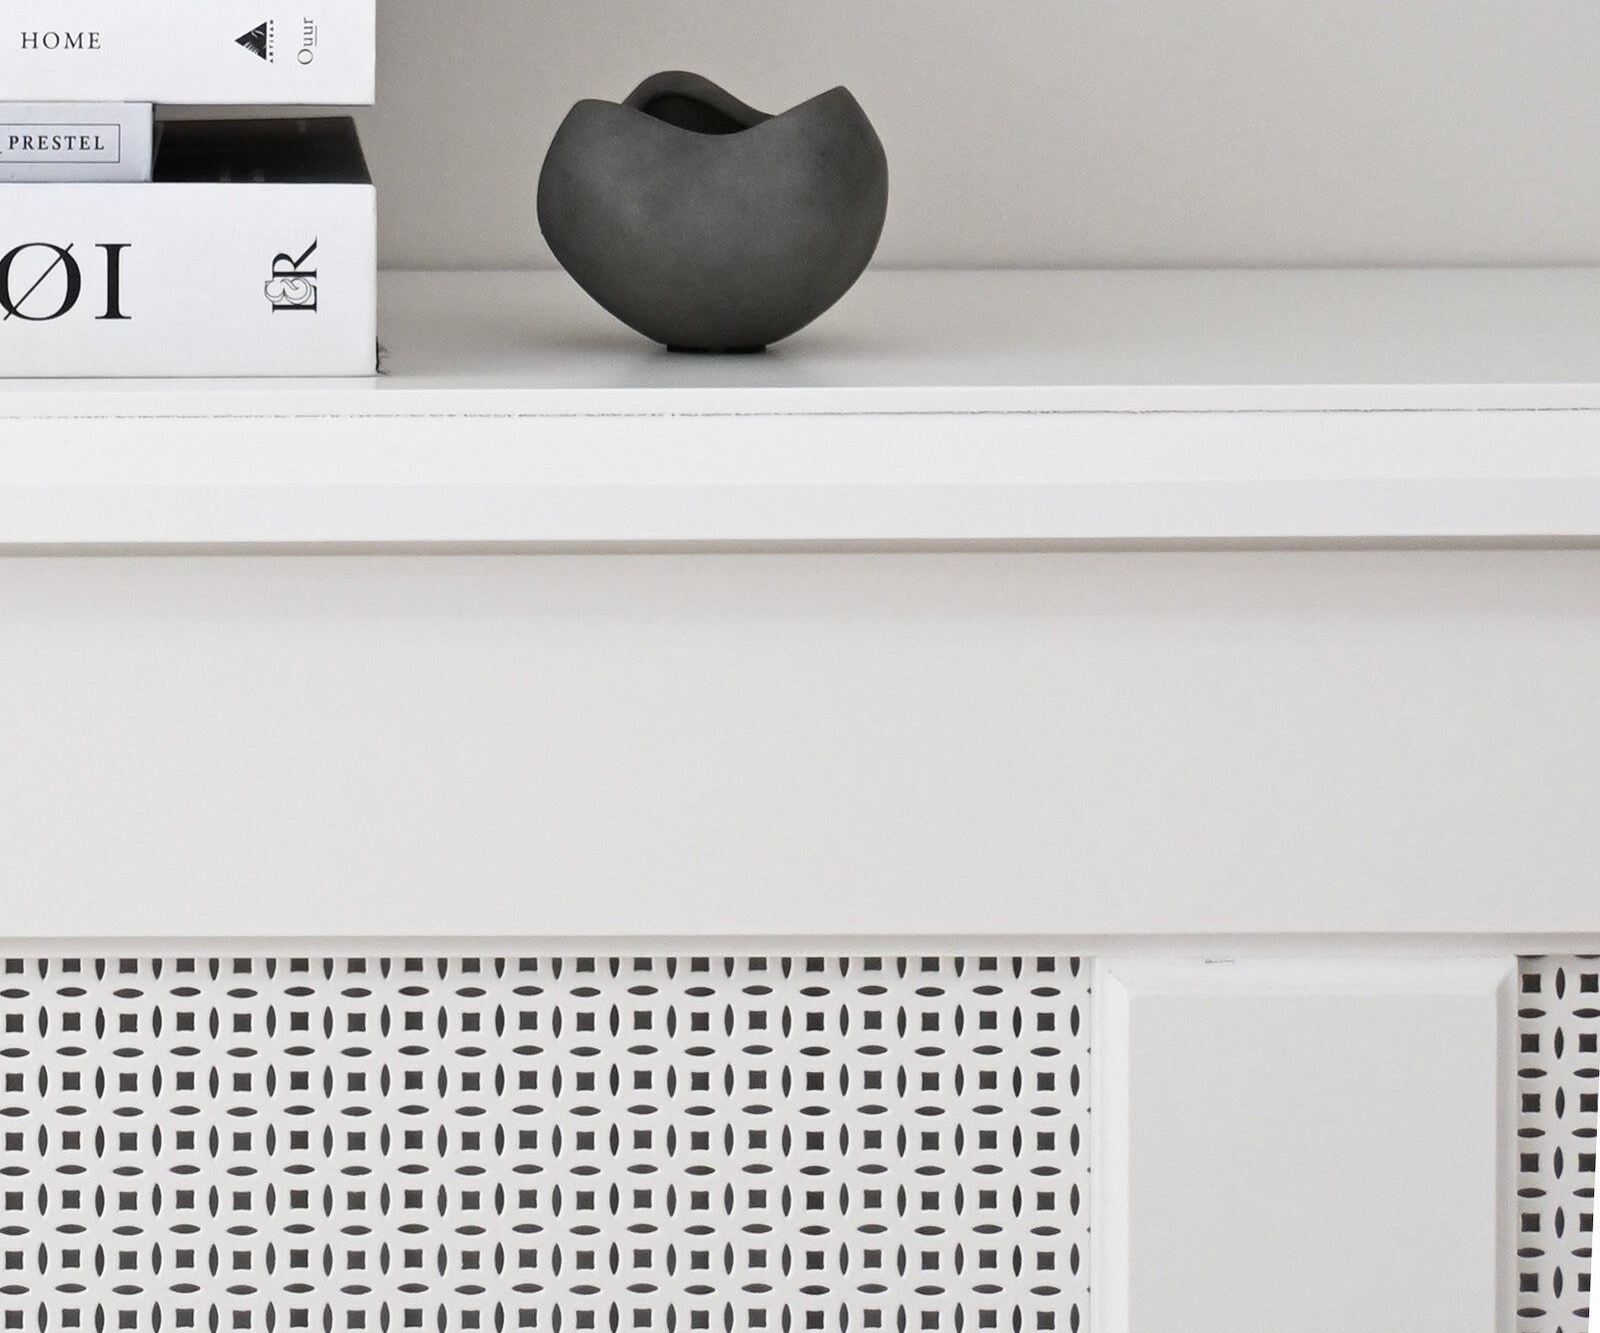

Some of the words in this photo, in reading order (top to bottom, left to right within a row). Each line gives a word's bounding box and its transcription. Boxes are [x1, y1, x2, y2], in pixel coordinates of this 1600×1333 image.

[21, 31, 101, 50] HOME
[297, 17, 315, 66] Ouur
[8, 135, 105, 151] PRESTEL
